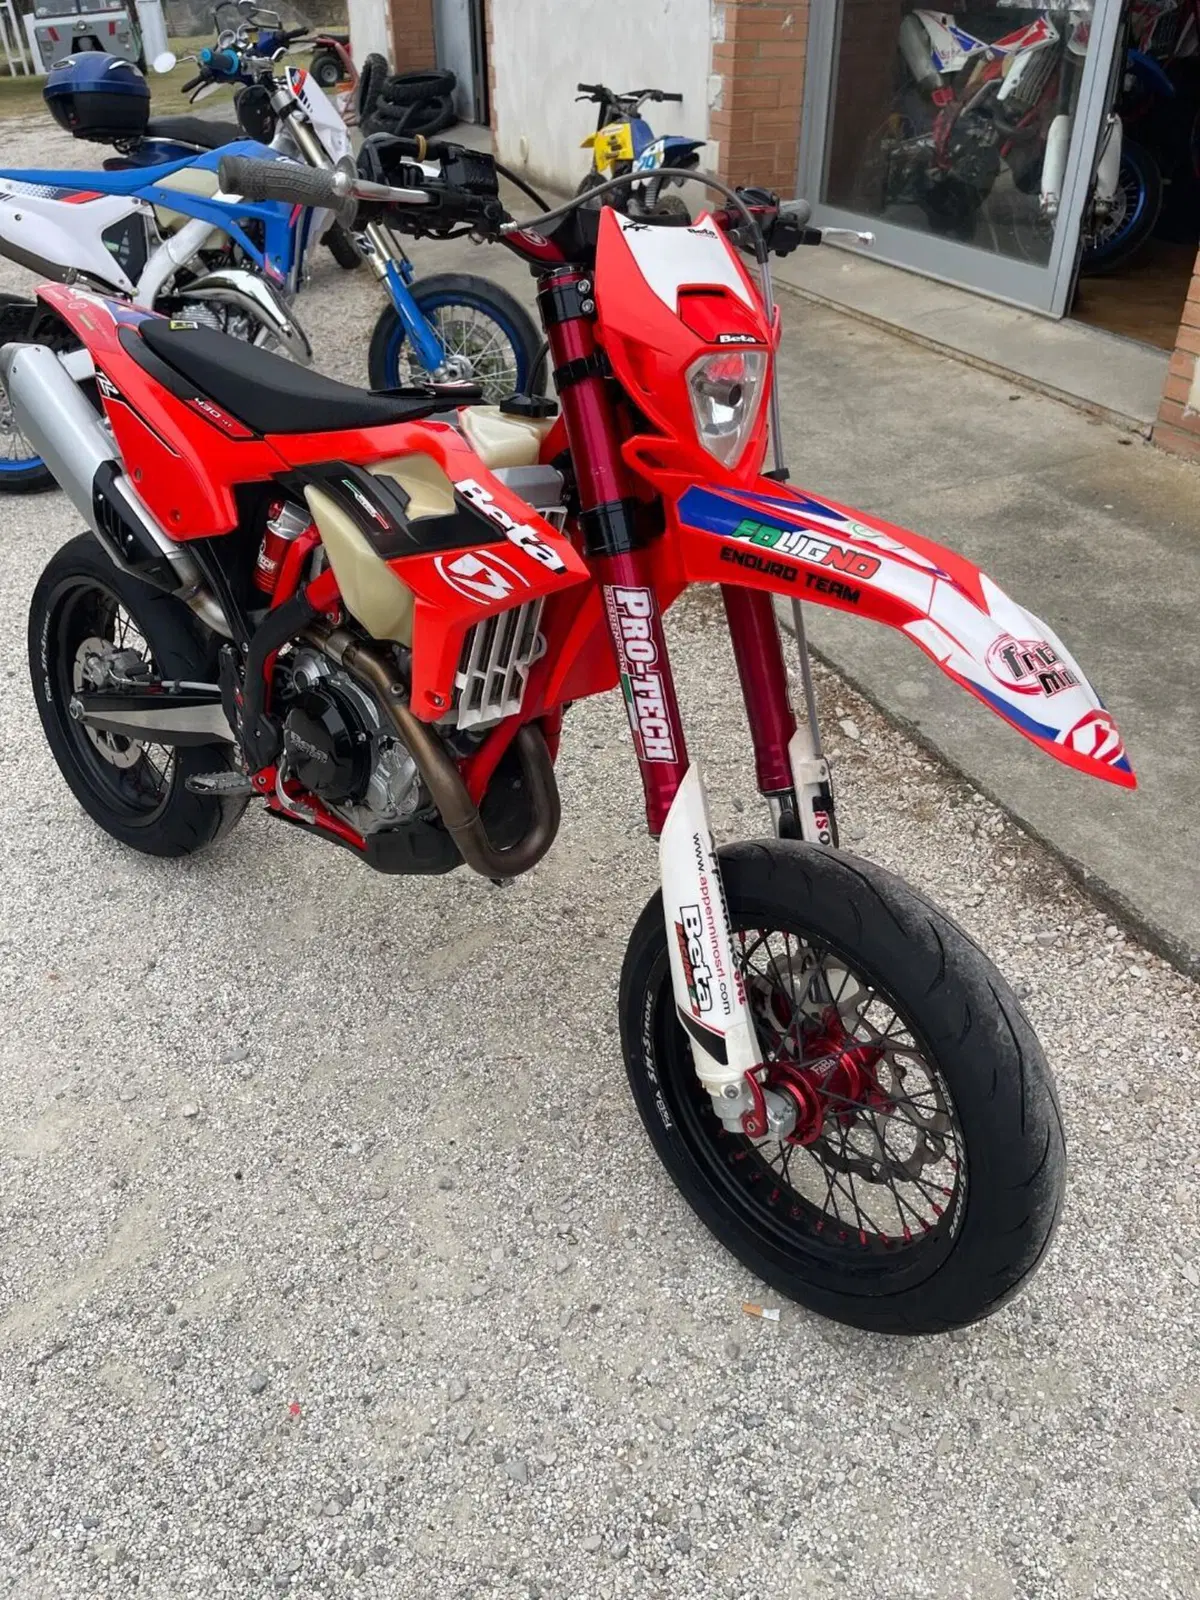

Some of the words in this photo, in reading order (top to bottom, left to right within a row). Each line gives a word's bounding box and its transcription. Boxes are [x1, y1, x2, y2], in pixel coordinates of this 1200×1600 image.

[719, 334, 756, 344] Beta
[193, 397, 222, 419] 430
[453, 477, 568, 574] Beta
[730, 517, 882, 580] FOLIGNO
[719, 545, 800, 582] ENDURO
[803, 571, 861, 605] TEAM
[614, 589, 674, 761] PRO-TECH
[680, 903, 714, 1012] Beta
[692, 832, 734, 1016] www.appenninosrl.com
